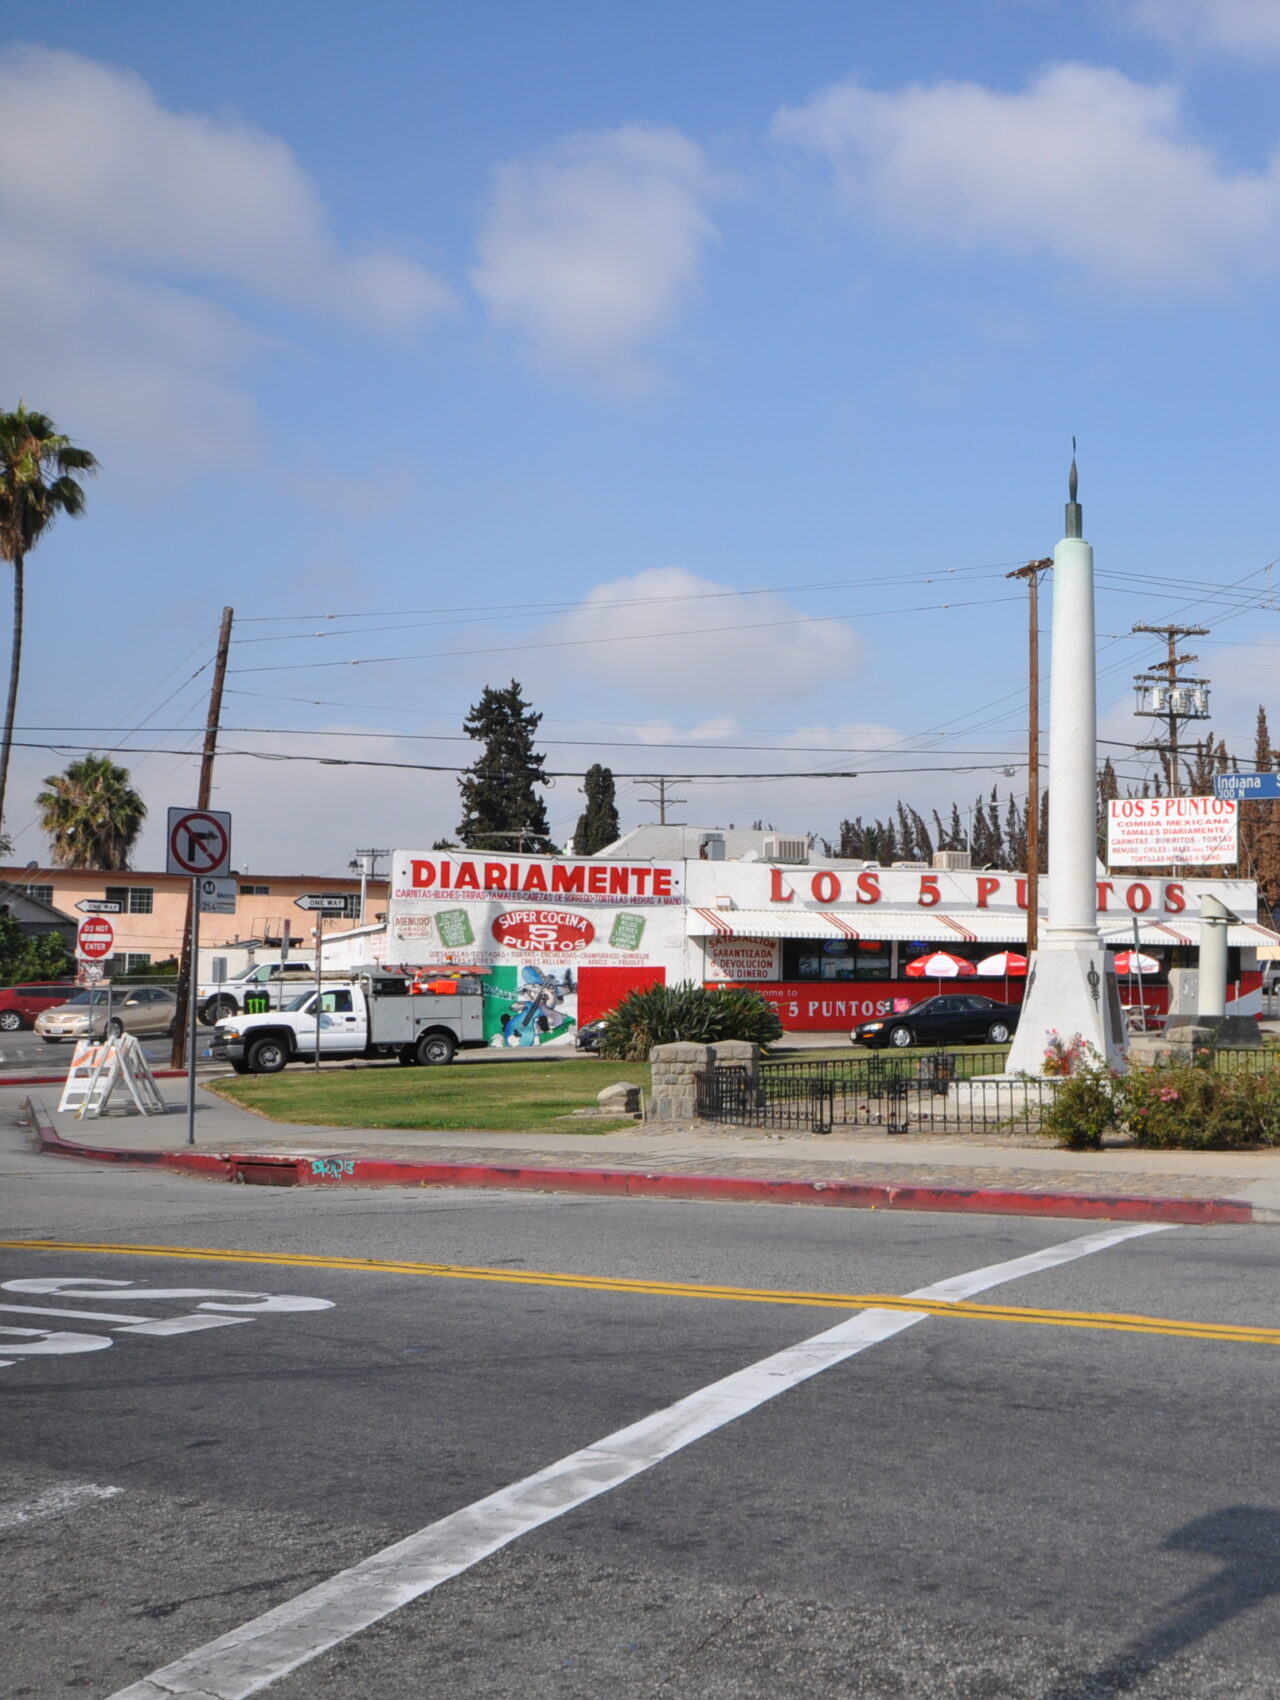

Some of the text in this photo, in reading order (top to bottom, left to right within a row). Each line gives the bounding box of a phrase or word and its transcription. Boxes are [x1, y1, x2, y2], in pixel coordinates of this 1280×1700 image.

[1217, 775, 1261, 789] Indiana
[1218, 788, 1245, 799] 300 N
[1111, 798, 1235, 818] LOS 5 PUNTOS
[1166, 818, 1229, 826] MEXICANA
[1121, 827, 1225, 836] TAMALES DIARIAMENTE
[1155, 836, 1195, 844] BURRITOS
[1202, 835, 1232, 843] TORTAS
[1205, 844, 1235, 852] TAMALES
[410, 859, 672, 896] DIARIAMENTE
[769, 868, 1186, 914] LOS 5 PUTOS
[395, 889, 682, 906] CARNITAS BUCHES TRIPAS TAMALES CABEZAS DE BORREGO TORTILLAS HECHAS A MANO
[202, 902, 216, 911] 254
[395, 916, 430, 926] MENUDO
[498, 911, 588, 932] SUPER COCINA
[84, 924, 109, 932] DO NOT
[528, 924, 558, 941] 5
[502, 935, 586, 951] PUNTOS
[511, 951, 535, 959] TORTAS
[712, 949, 773, 958] GARANTIZADA
[720, 959, 773, 968] DEVOLUCION
[723, 969, 734, 978] SU
[737, 969, 768, 978] DINERO
[787, 989, 798, 997] to
[788, 1001, 799, 1017] 5
[808, 1000, 886, 1017] PUNTOS
